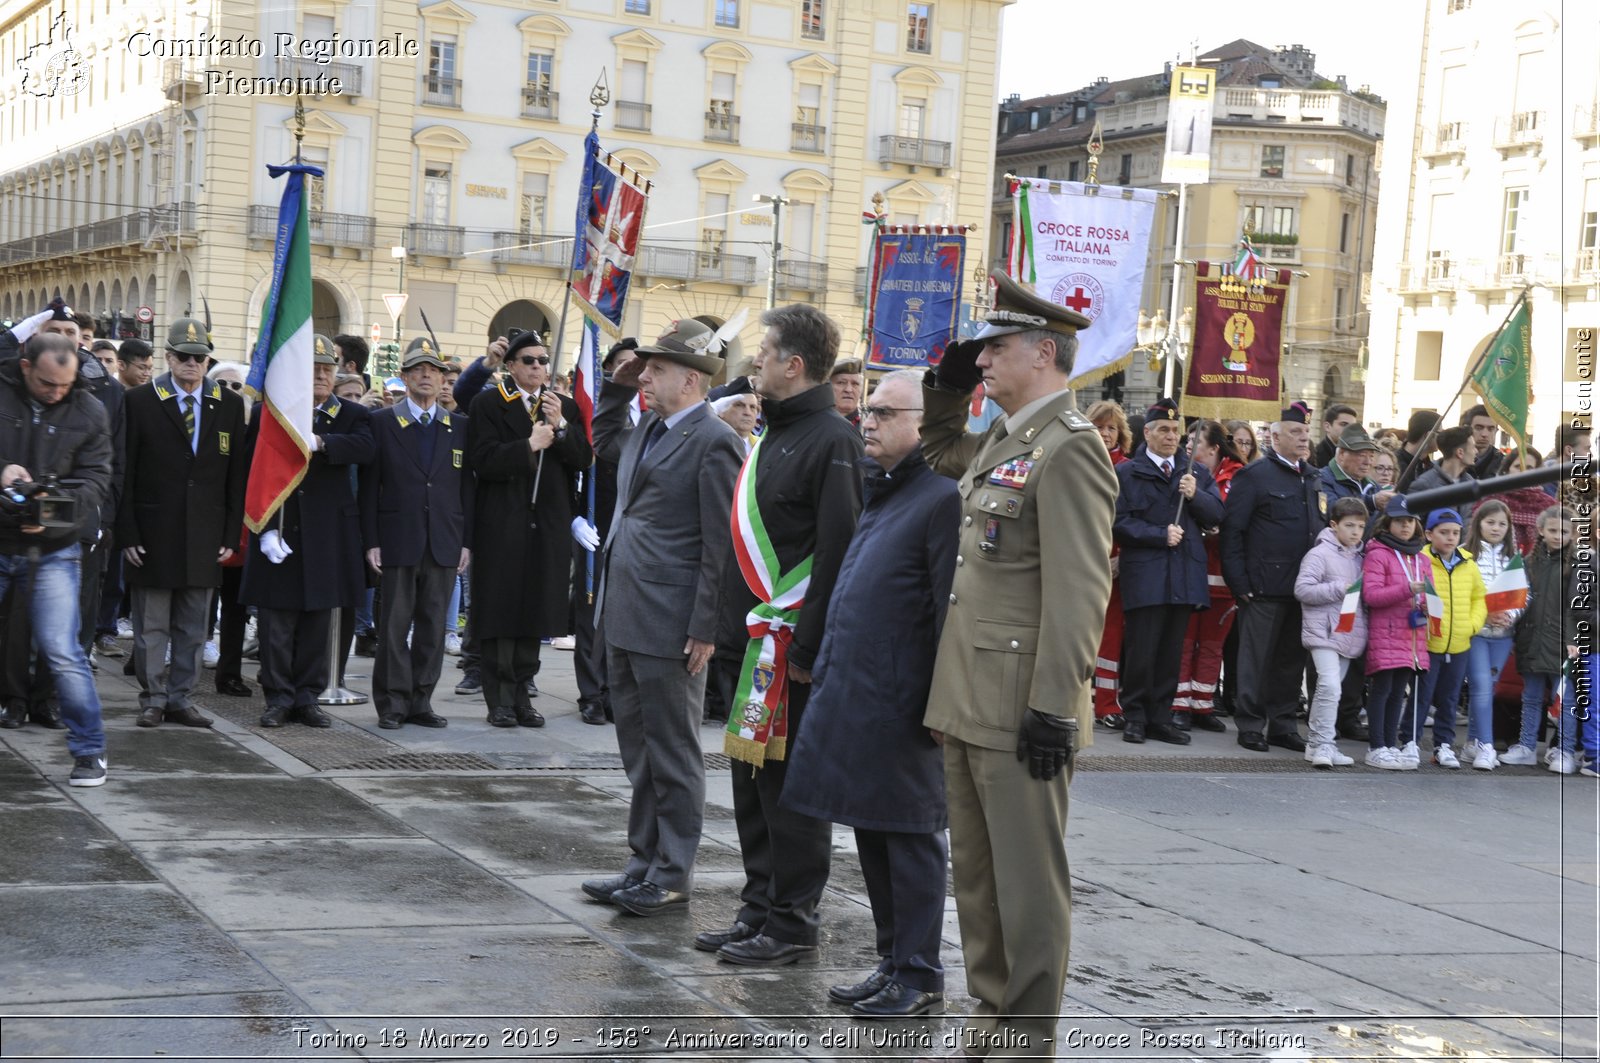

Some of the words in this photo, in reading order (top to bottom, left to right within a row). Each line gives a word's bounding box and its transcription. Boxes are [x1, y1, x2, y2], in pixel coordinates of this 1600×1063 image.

[1037, 222, 1083, 237] CROCE
[1087, 226, 1130, 241] ROSSA
[1054, 239, 1111, 255] ITALIANA
[1045, 254, 1081, 264] COMITATO
[1092, 258, 1118, 267] TORINO
[889, 346, 927, 360] TORINO
[1236, 374, 1246, 384] DI
